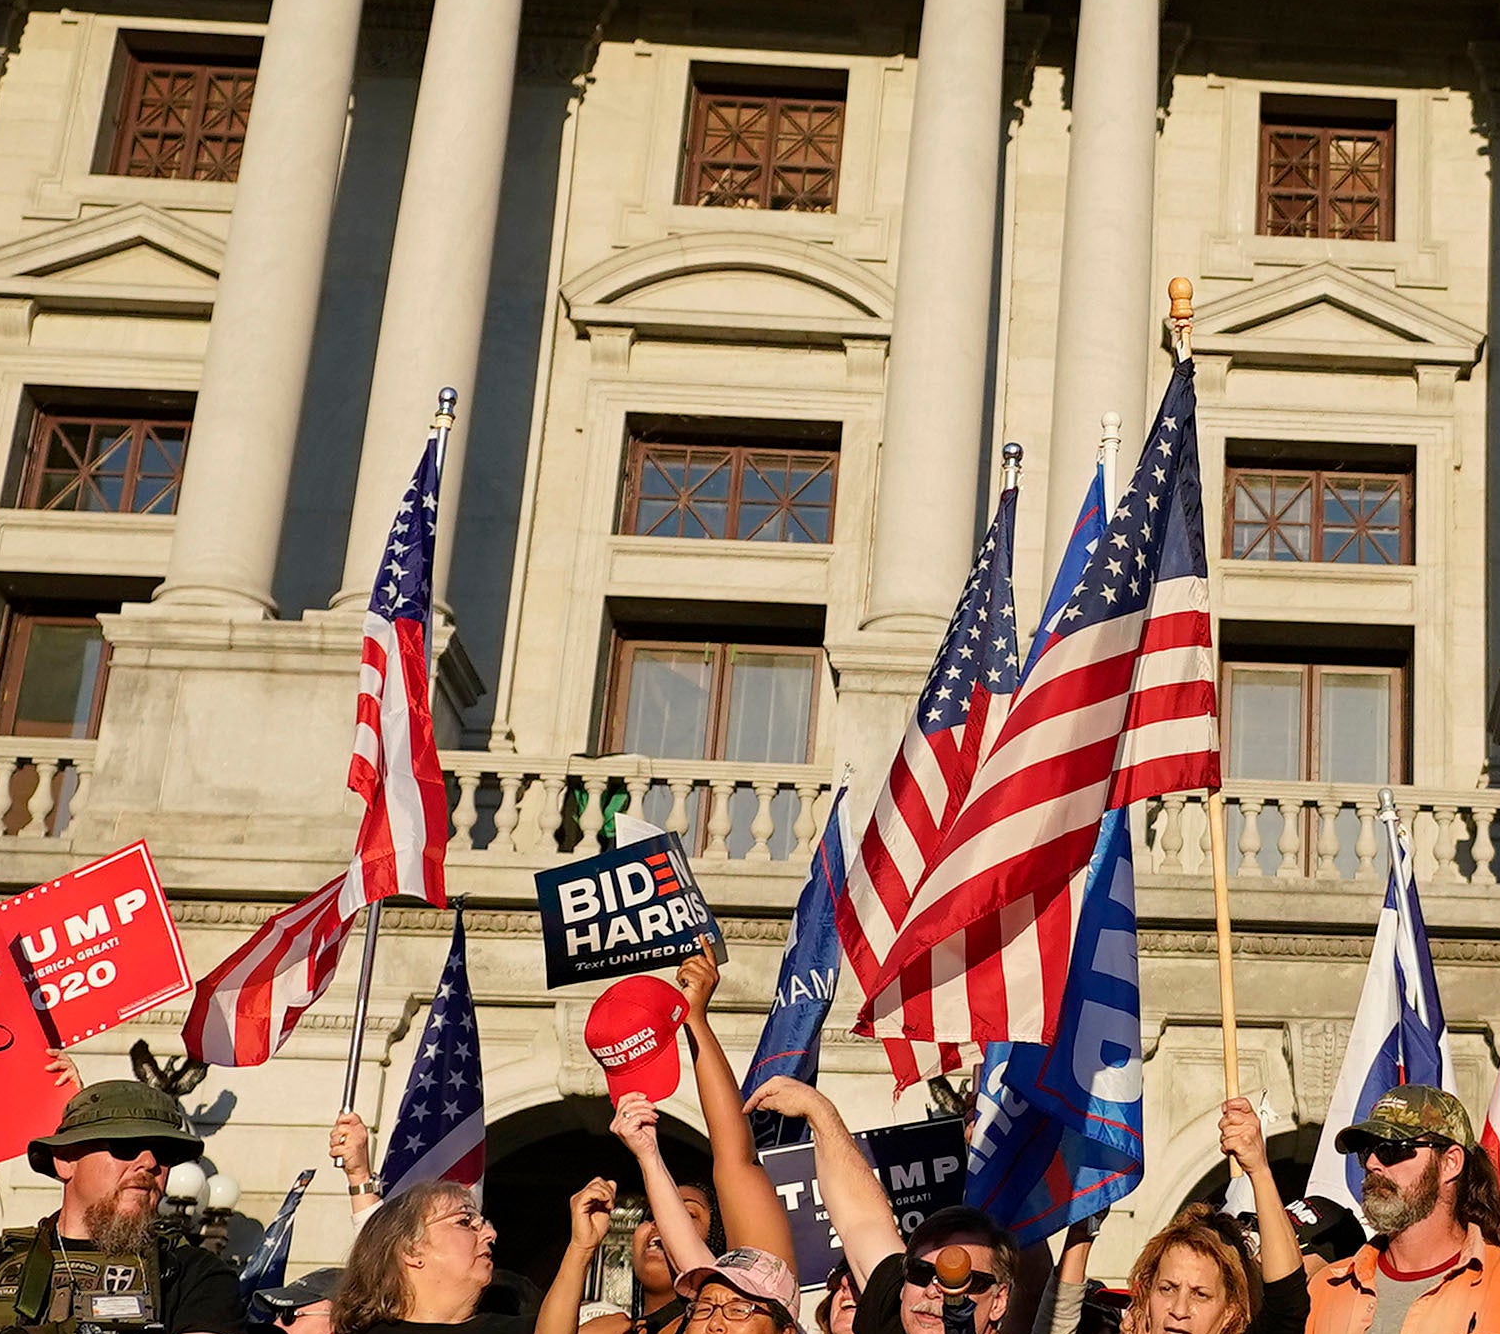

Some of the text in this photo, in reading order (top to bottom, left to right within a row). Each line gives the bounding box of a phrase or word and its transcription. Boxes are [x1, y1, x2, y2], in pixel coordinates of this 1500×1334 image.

[558, 850, 693, 924] BIDEN
[21, 889, 147, 963] UMP
[566, 892, 708, 957] HARRIS
[22, 936, 121, 983] AMERICA GREAT!
[575, 959, 605, 972] Text
[608, 944, 676, 965] UNITED
[679, 939, 693, 954] to
[31, 960, 117, 1011] 020
[614, 1026, 657, 1053] AMERICA
[627, 1037, 658, 1062] AGAIN
[775, 1154, 960, 1213] TMP
